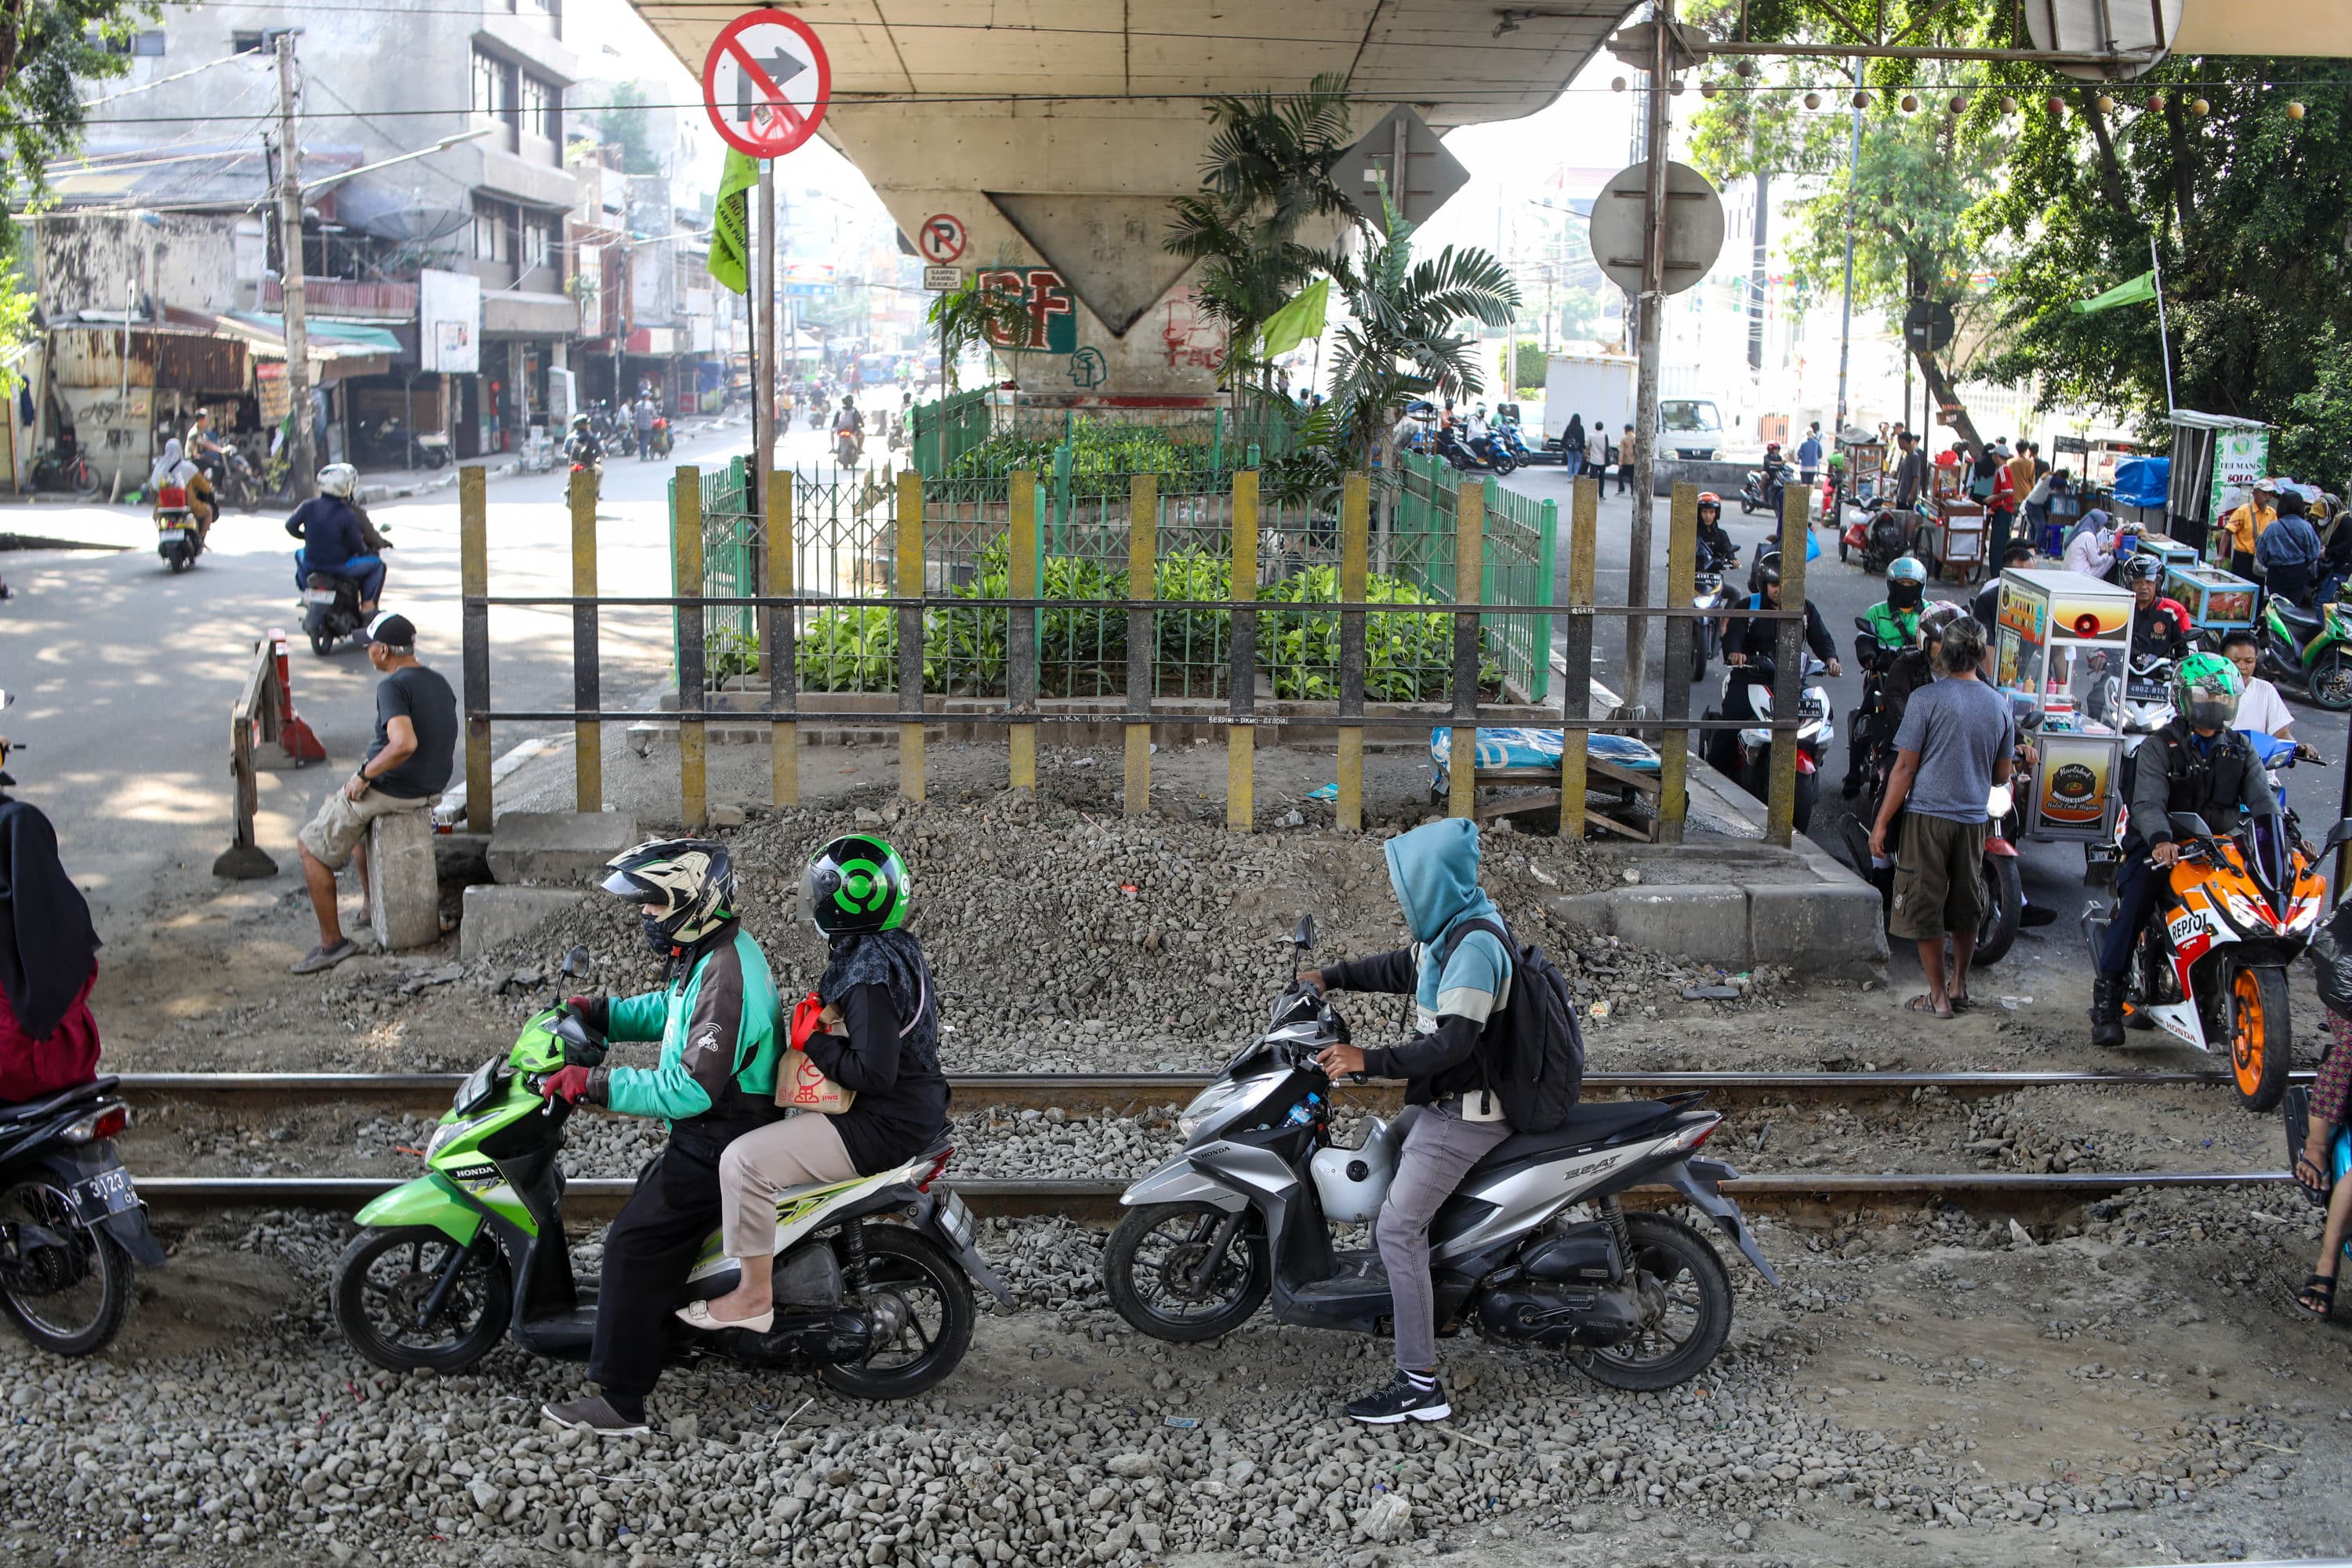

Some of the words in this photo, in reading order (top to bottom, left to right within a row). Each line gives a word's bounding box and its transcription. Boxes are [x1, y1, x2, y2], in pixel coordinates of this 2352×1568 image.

[2166, 1021, 2197, 1043] HONDA
[1200, 1146, 1231, 1159] HONDA
[456, 1166, 495, 1178] HONDA
[71, 1188, 83, 1206] B
[89, 1173, 124, 1199] 3123
